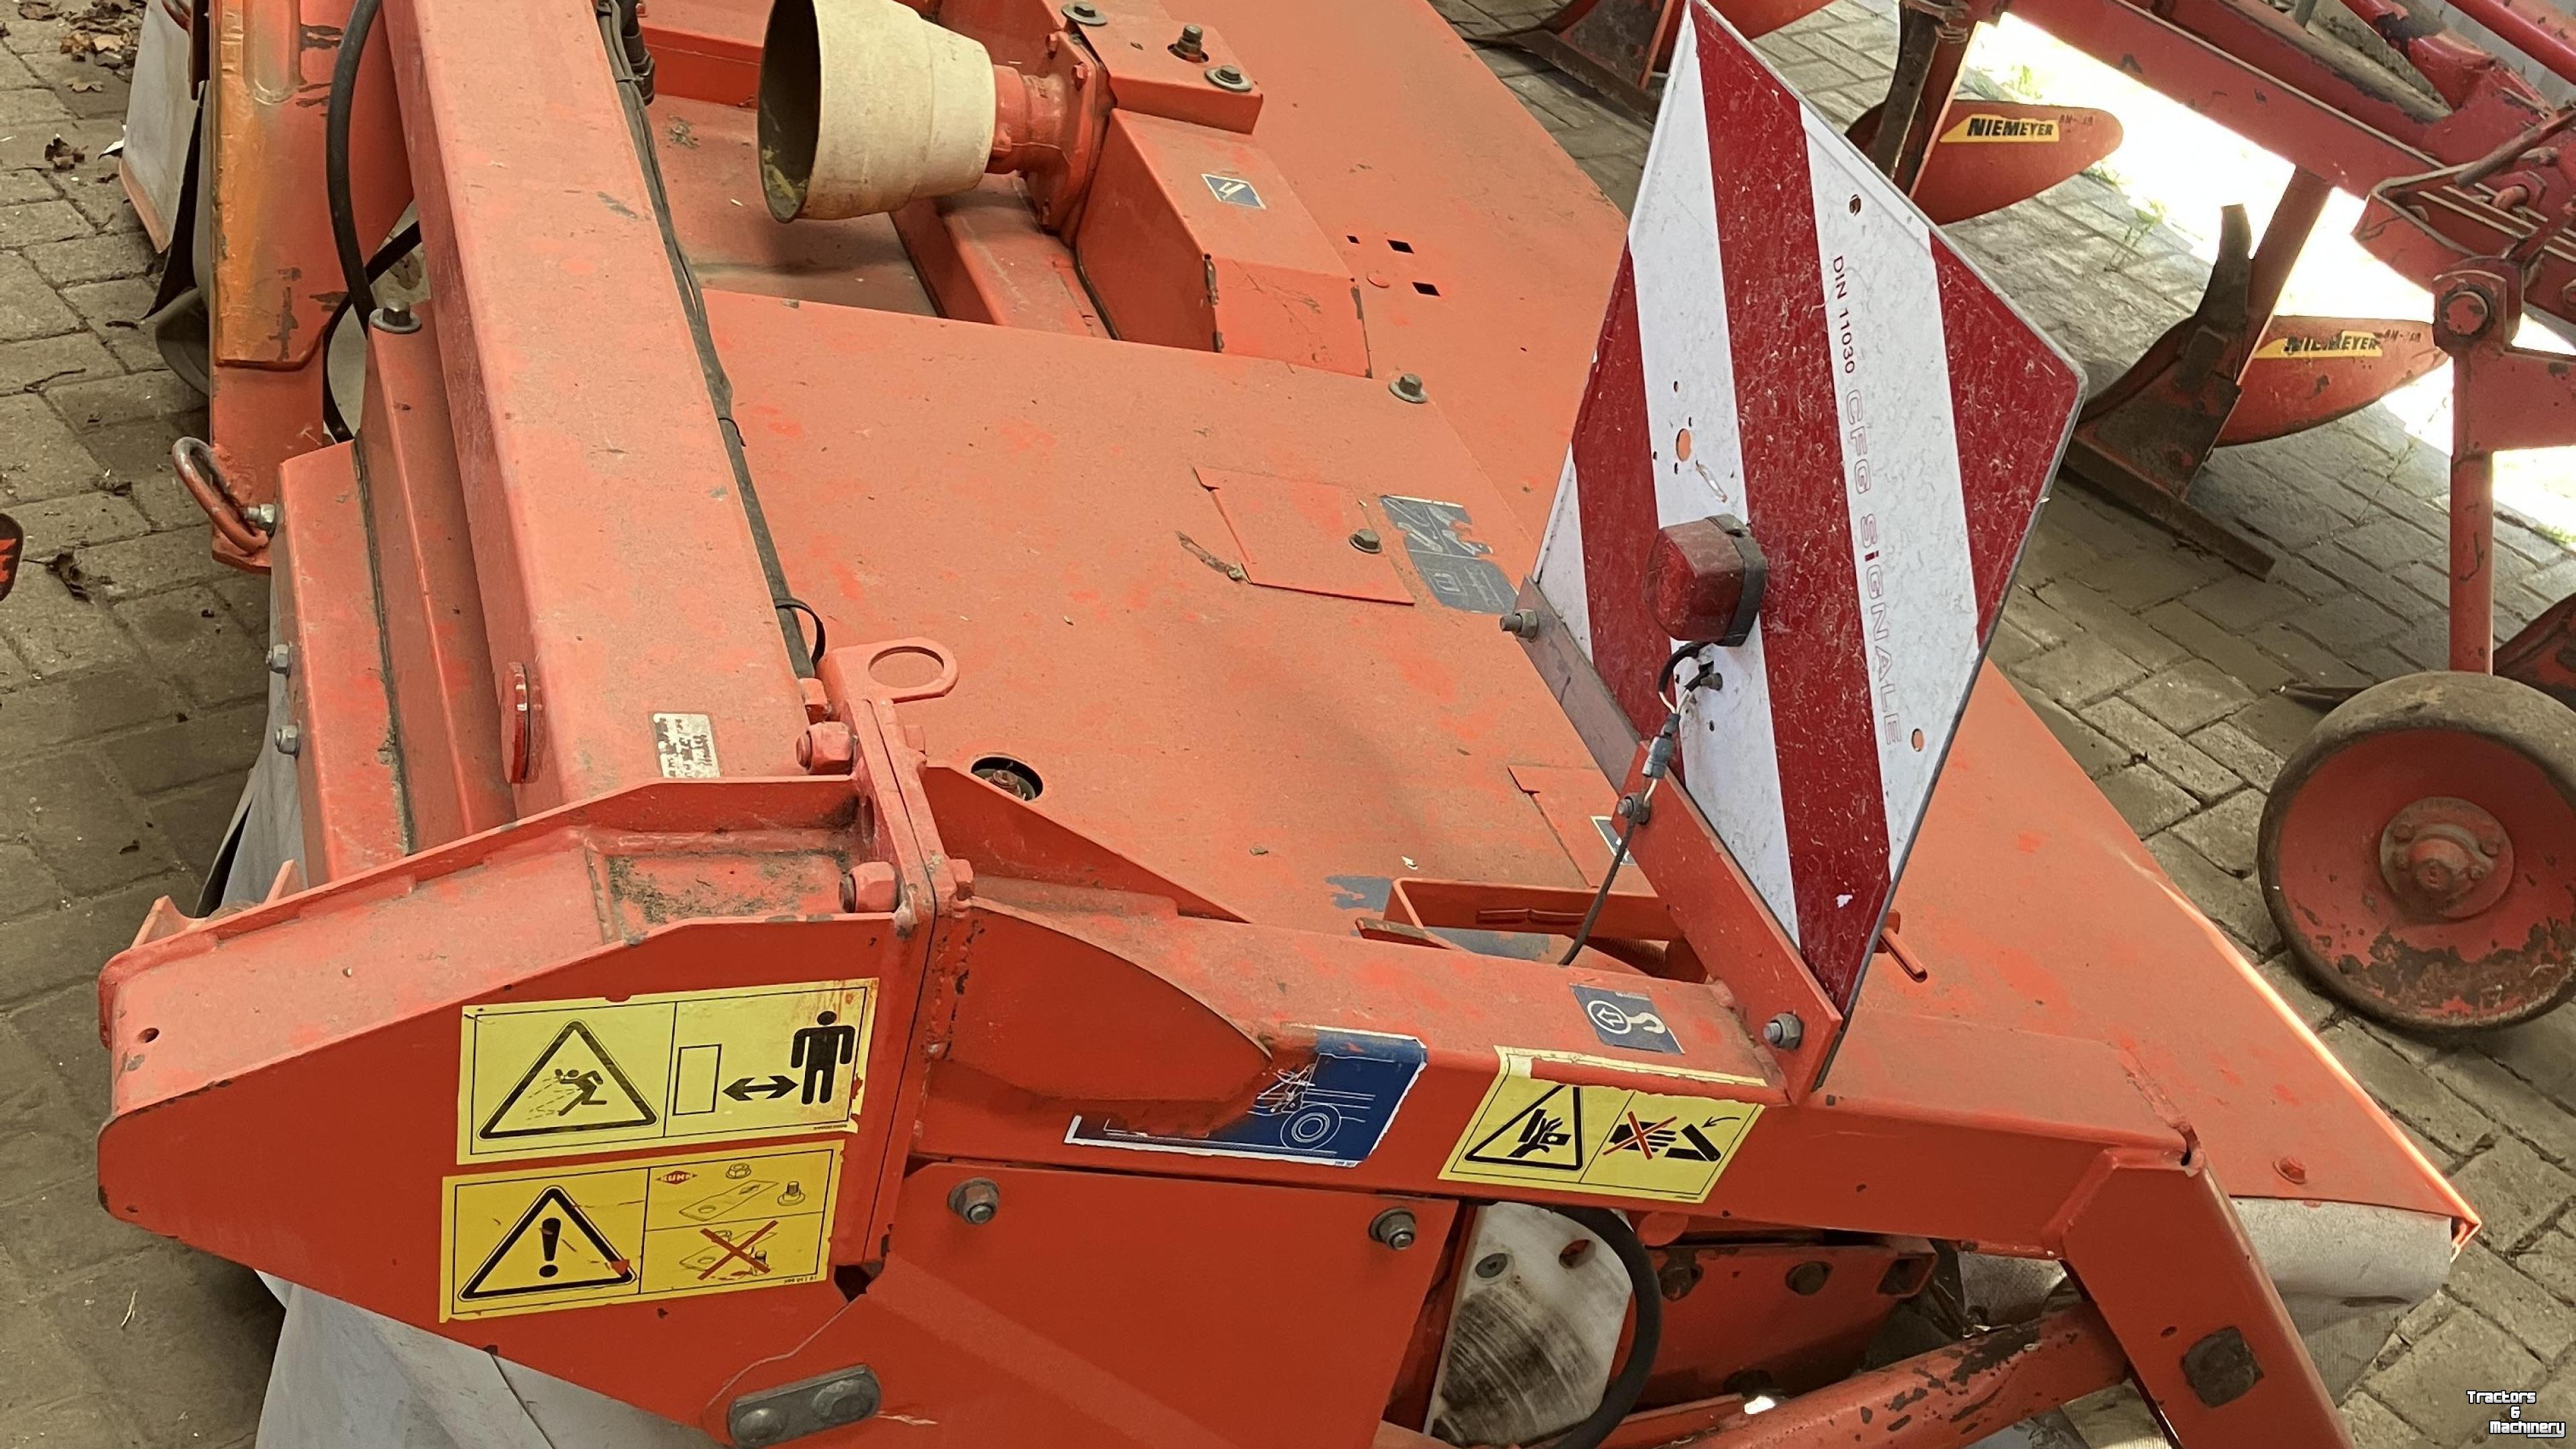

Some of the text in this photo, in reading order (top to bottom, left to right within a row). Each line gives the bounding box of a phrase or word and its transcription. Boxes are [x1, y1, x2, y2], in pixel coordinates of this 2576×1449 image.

[1966, 117, 2053, 137] NIEMEYER
[1833, 256, 1855, 374] DIN 11030
[1846, 389, 1871, 495] CFG
